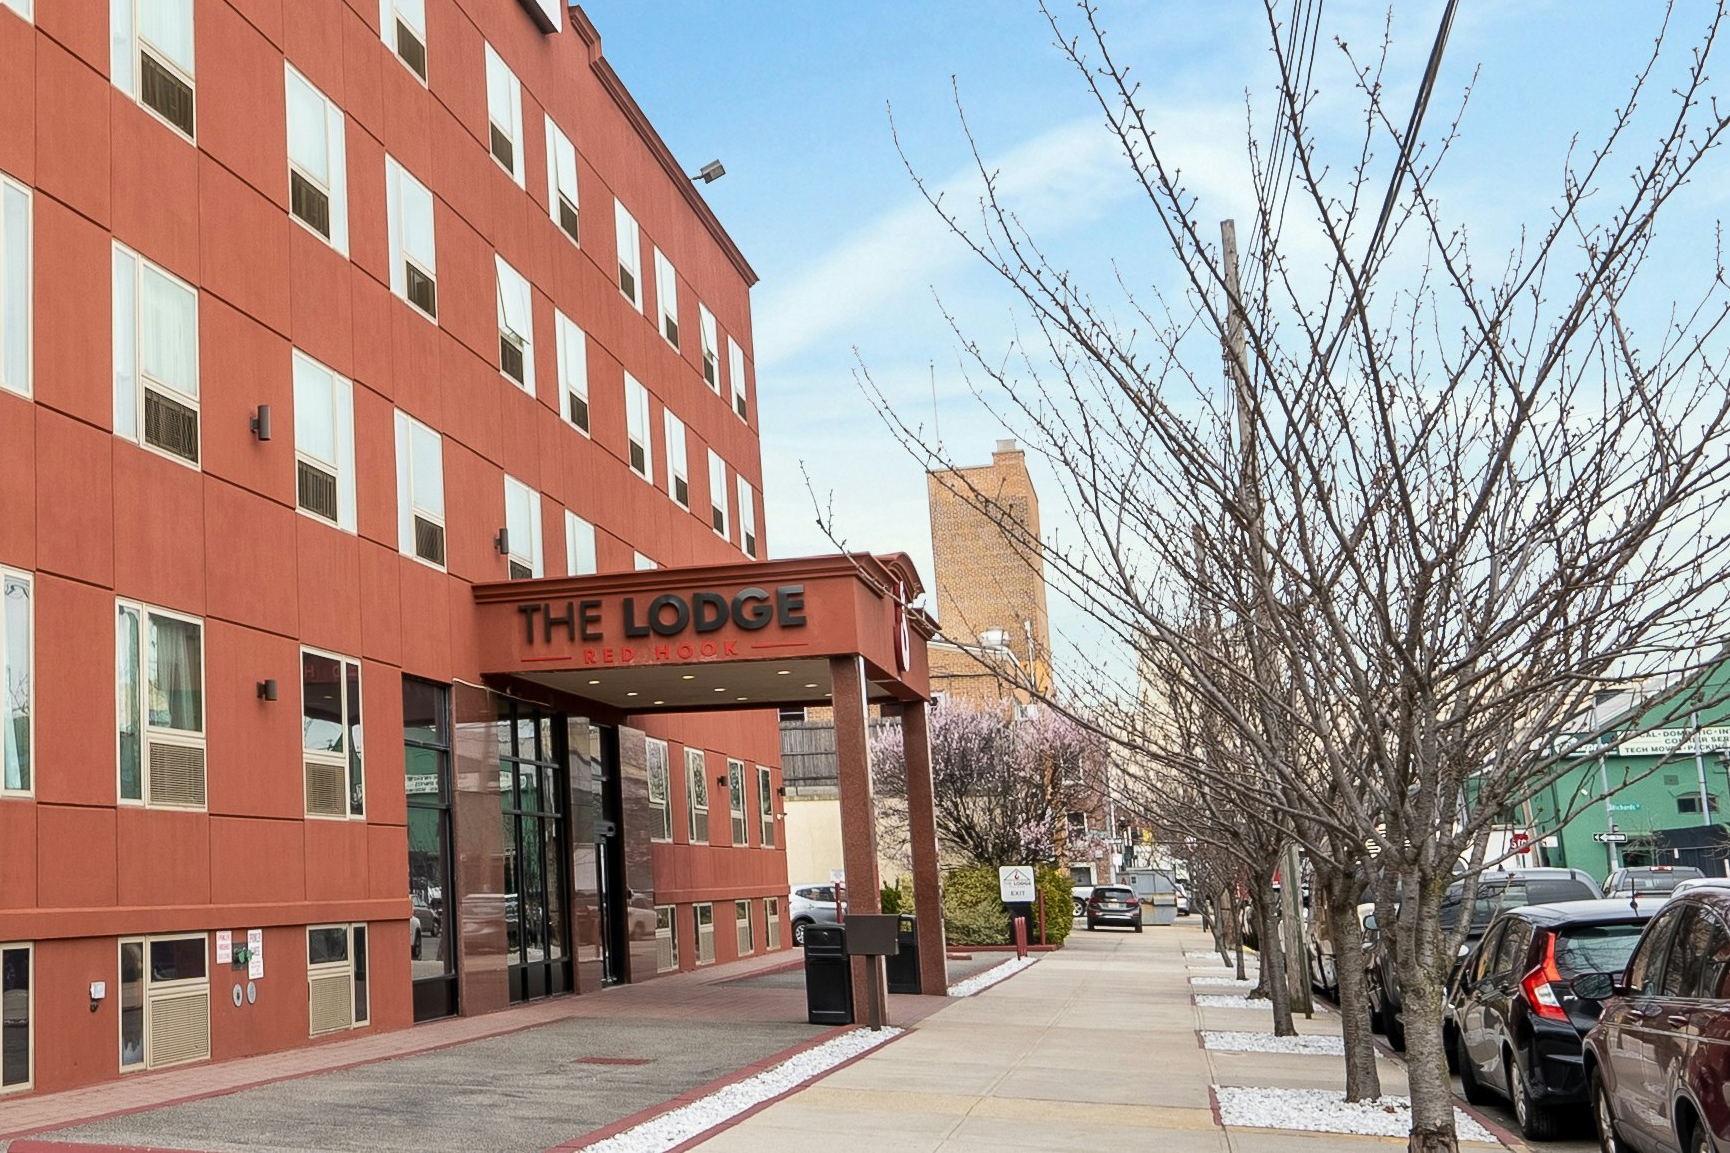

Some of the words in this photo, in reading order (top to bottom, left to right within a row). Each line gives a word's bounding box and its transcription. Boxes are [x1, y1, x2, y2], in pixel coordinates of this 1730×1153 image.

[518, 599, 603, 644] THE
[623, 584, 807, 638] LODGE
[584, 647, 635, 664] RED
[655, 640, 739, 660] HOOK
